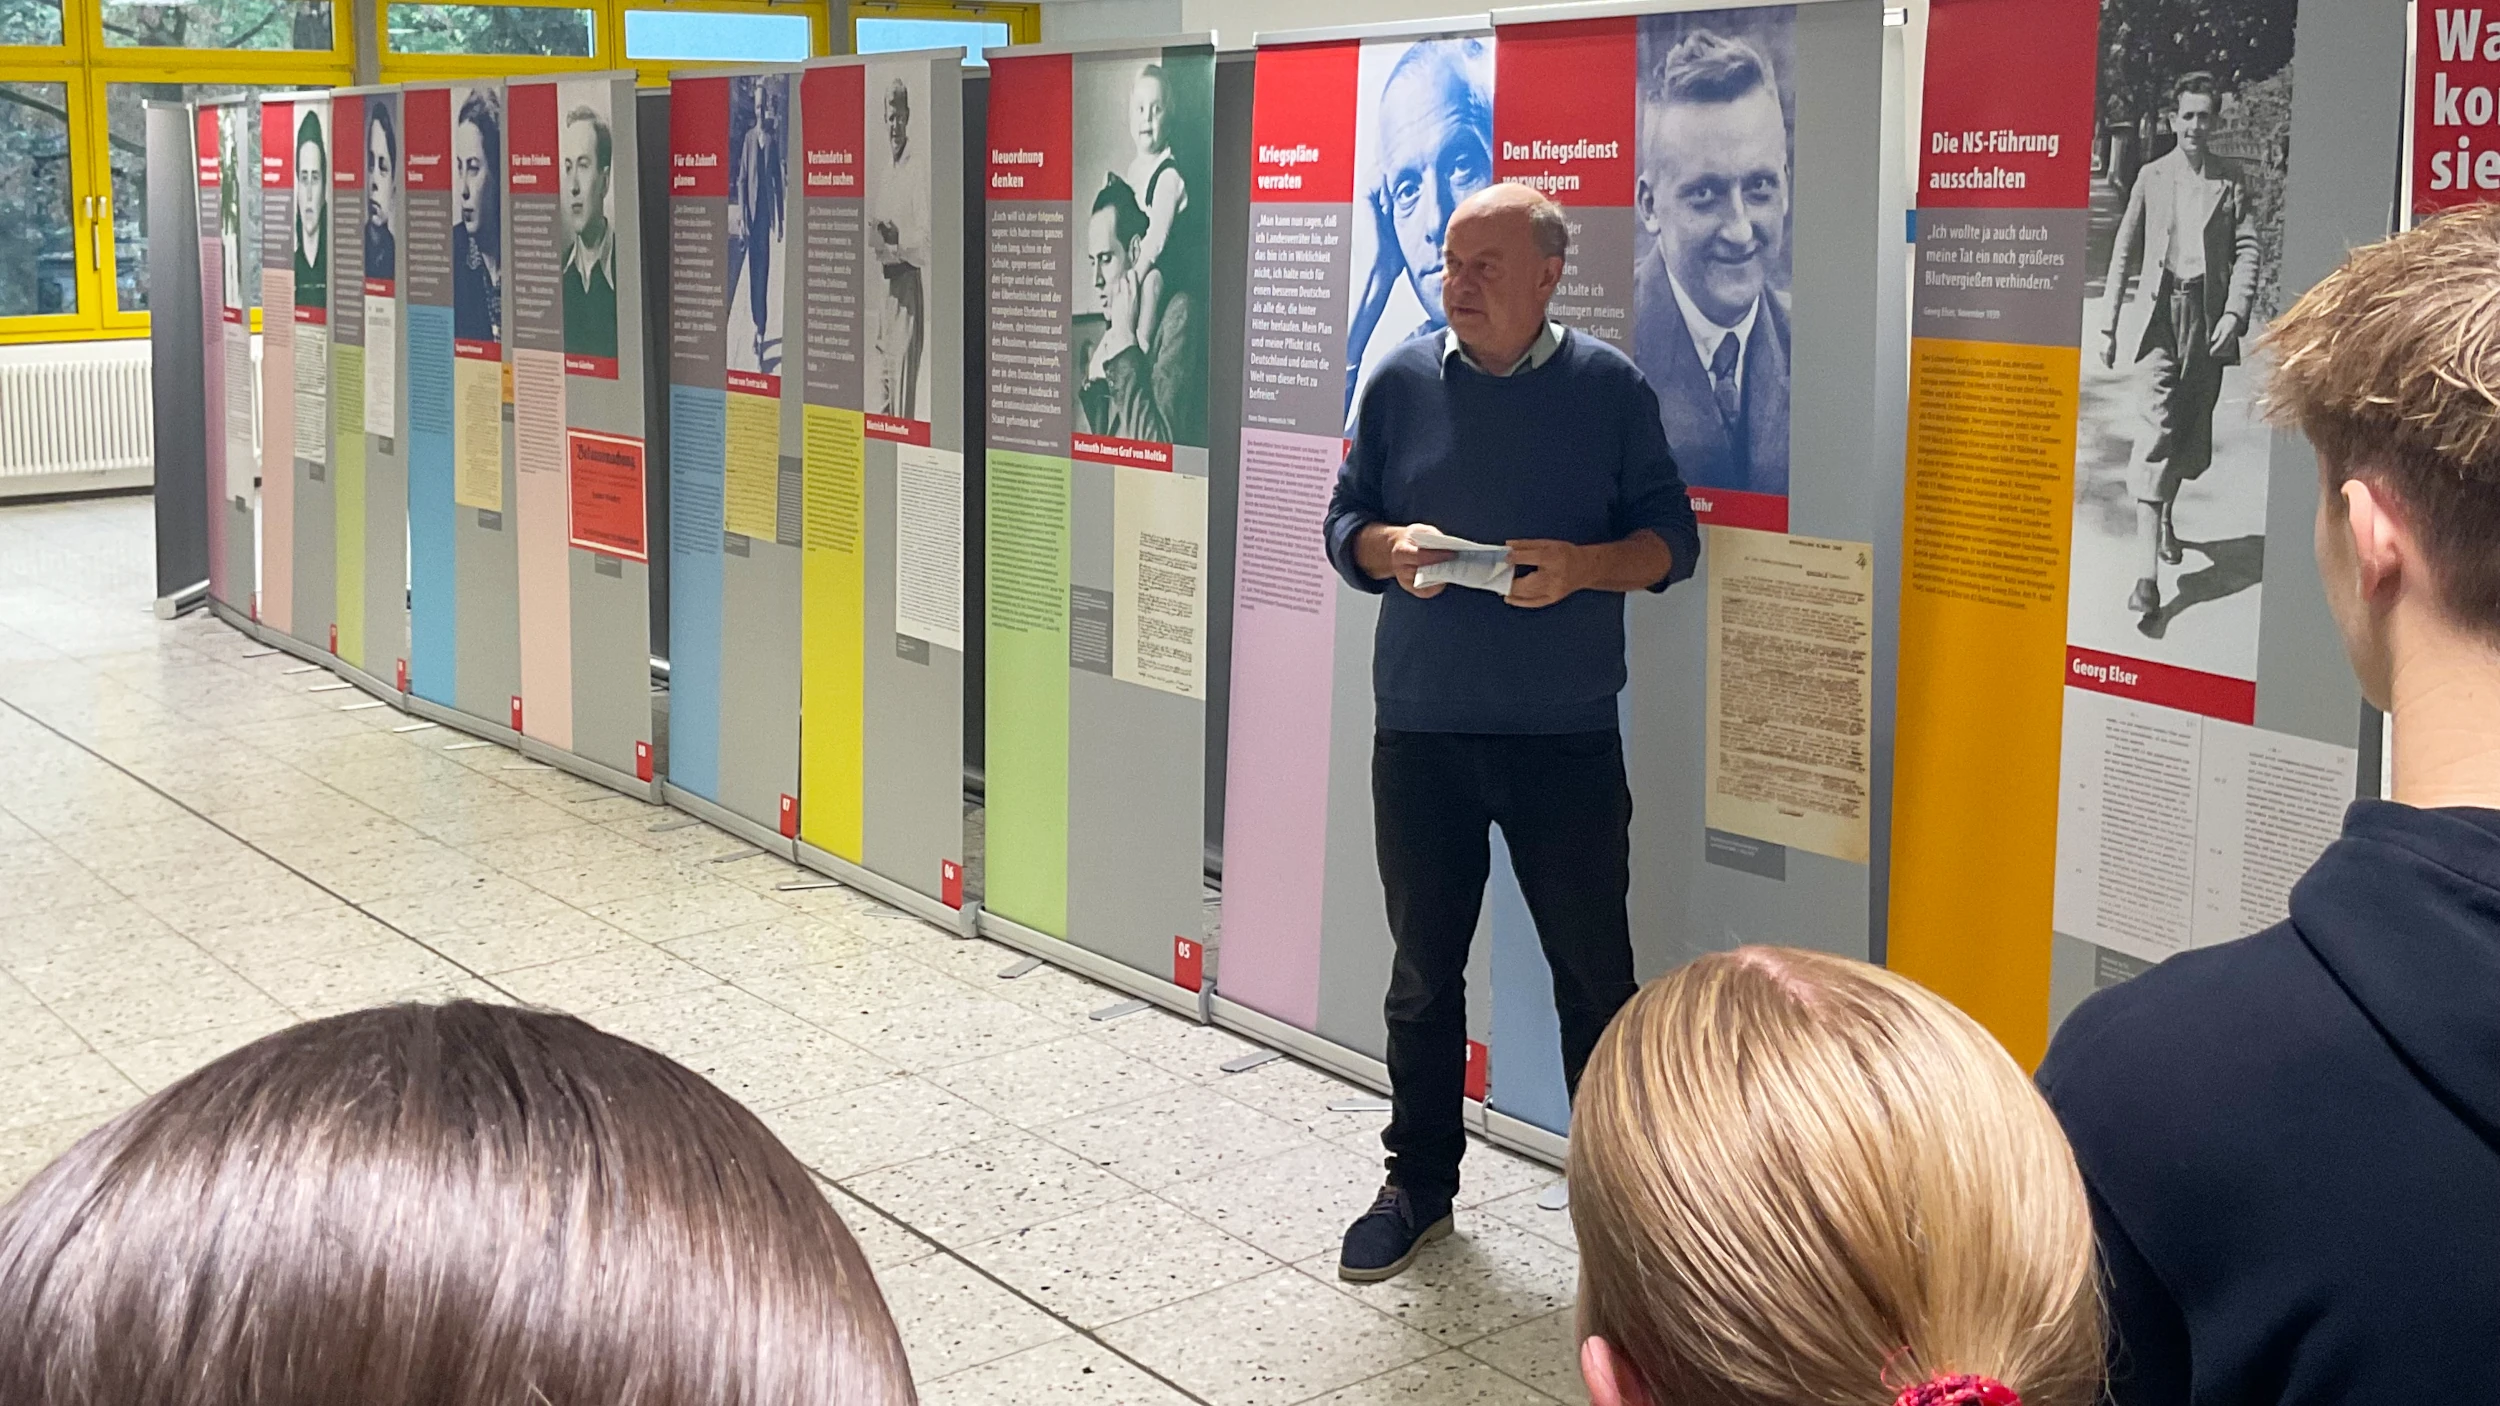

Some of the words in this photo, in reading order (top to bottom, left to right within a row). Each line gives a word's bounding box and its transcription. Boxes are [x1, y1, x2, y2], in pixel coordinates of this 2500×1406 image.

[2434, 72, 2500, 126] ko
[1503, 141, 1529, 160] Den
[1532, 140, 1618, 163] Kriegsdienst
[1932, 132, 1958, 153] Die
[1962, 130, 2059, 157] NS-Führung
[808, 149, 843, 164] Verbündete
[992, 148, 1044, 167] Neuordnung
[1259, 145, 1318, 166] Kriegspläne
[808, 172, 832, 185] Ausland
[833, 172, 853, 186] suchen
[992, 172, 1023, 188] denken
[1258, 173, 1301, 189] verraten
[1930, 167, 2026, 189] ausschalten
[1950, 225, 1979, 239] wollte
[1981, 225, 1990, 243] ja
[1992, 225, 2016, 240] auch
[2018, 225, 2047, 240] durch
[1927, 248, 1956, 263] meine
[1960, 248, 1972, 263] Tat
[1976, 249, 1990, 264] ein
[1992, 249, 2016, 264] noch
[2018, 250, 2064, 269] größeres
[1925, 270, 1992, 291] Blutvergießen
[1555, 285, 1567, 296] So
[1568, 285, 1589, 296] halte
[1591, 285, 1604, 297] ich
[1548, 302, 1591, 319] Rüstungen
[1594, 306, 1624, 318] meines
[1590, 325, 1621, 339] Schutz.
[1691, 497, 1714, 512] töhr
[2072, 658, 2106, 683] Georg
[2109, 666, 2138, 686] Elser
[1178, 941, 1190, 959] 05
